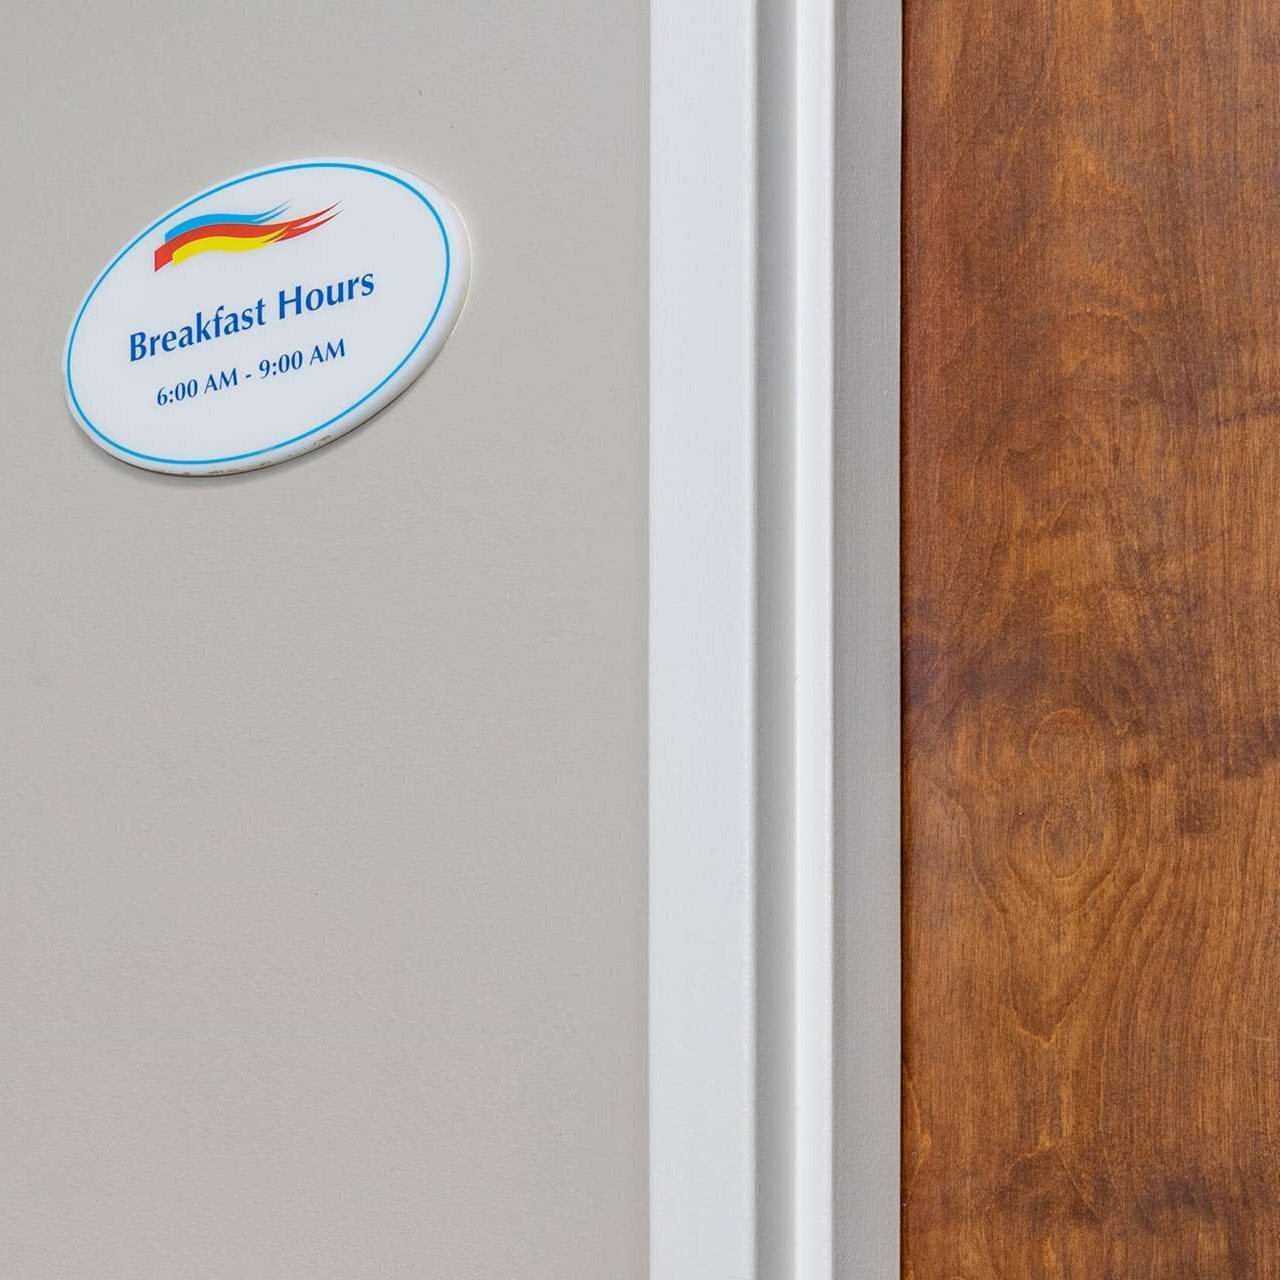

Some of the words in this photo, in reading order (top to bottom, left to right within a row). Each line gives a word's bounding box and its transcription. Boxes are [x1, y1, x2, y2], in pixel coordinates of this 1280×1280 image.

[129, 298, 266, 362] Breakfast
[278, 273, 375, 320] Hours
[157, 378, 198, 406] 6:00
[204, 368, 238, 394] AM
[259, 350, 303, 379] 9:00
[310, 338, 346, 365] AM
